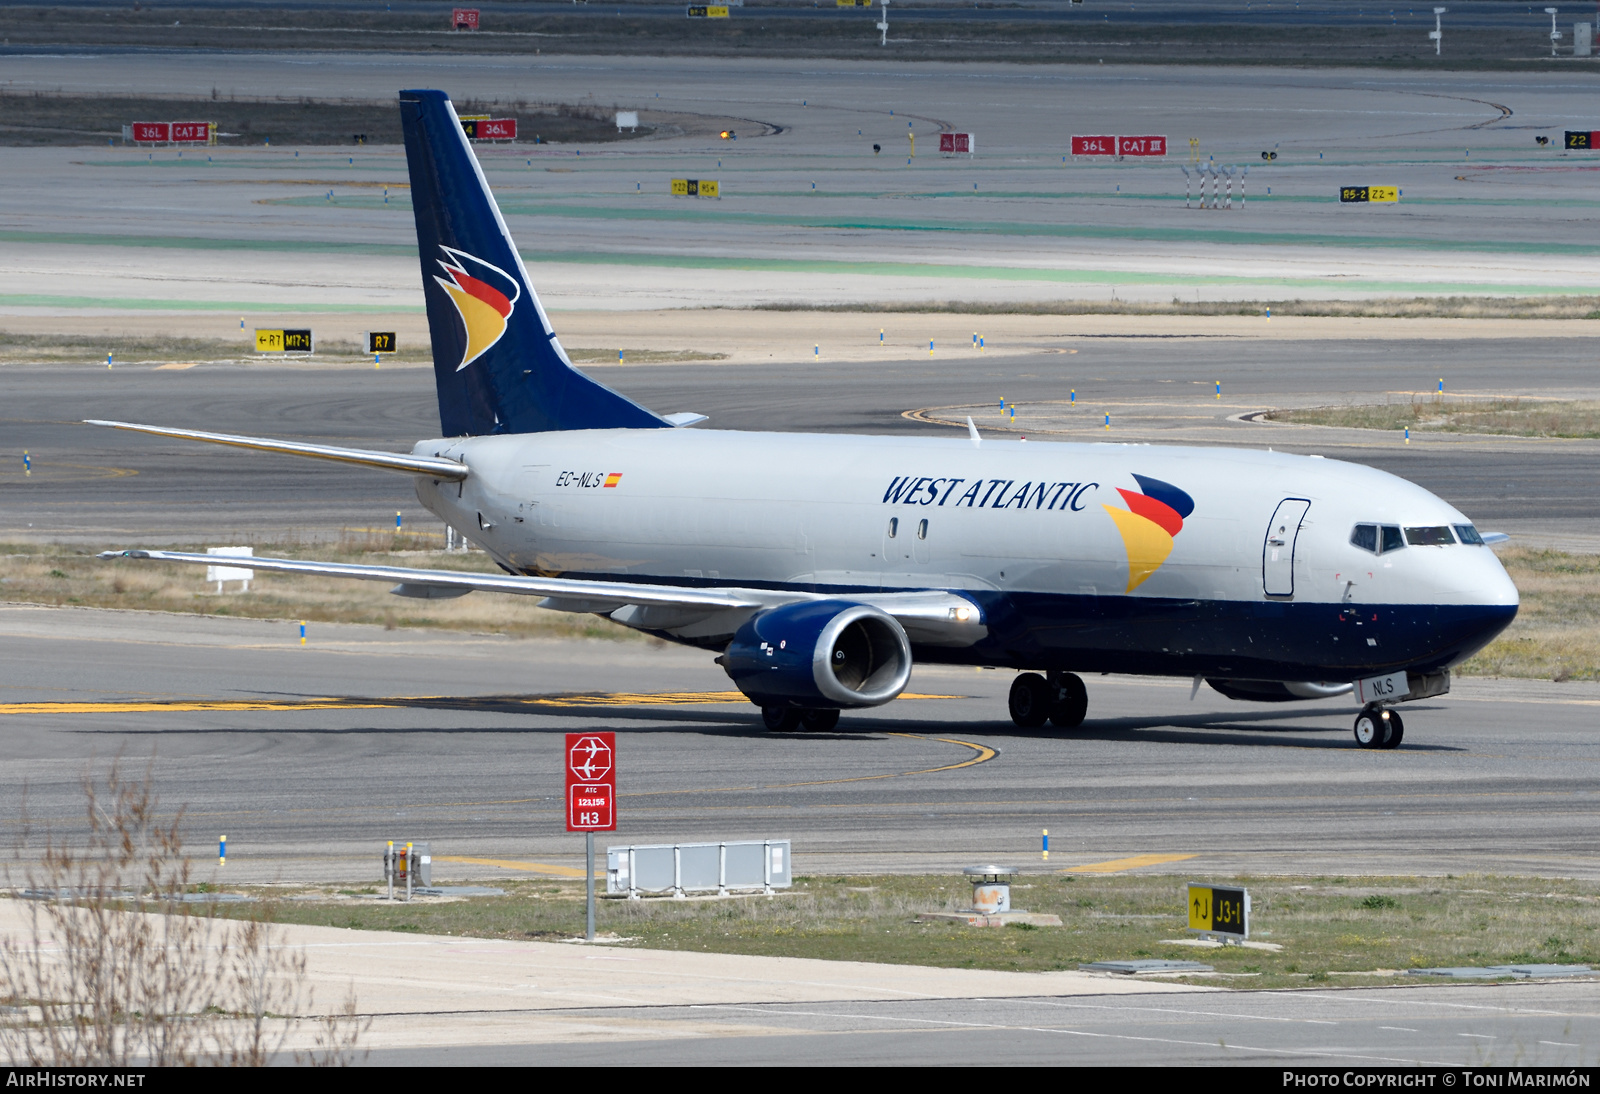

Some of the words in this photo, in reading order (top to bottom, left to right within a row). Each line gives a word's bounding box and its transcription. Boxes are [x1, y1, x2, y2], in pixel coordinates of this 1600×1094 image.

[142, 127, 162, 138] 36L
[175, 126, 193, 137] CAT
[196, 126, 206, 137] III
[486, 124, 508, 135] 36L
[1082, 140, 1106, 151] 36L
[1122, 140, 1146, 152] CAT
[1150, 140, 1162, 151] III
[1570, 135, 1586, 146] Z2
[1372, 189, 1385, 199] Z2
[269, 334, 281, 346] R7
[375, 335, 389, 348] R7
[555, 470, 604, 488] EC-NLS
[882, 476, 965, 506] WEST
[955, 479, 1100, 511] ATLANTIC
[1372, 678, 1394, 696] NLS
[580, 812, 599, 825] H3
[1201, 898, 1208, 920] J
[1216, 900, 1240, 924] J3-1
